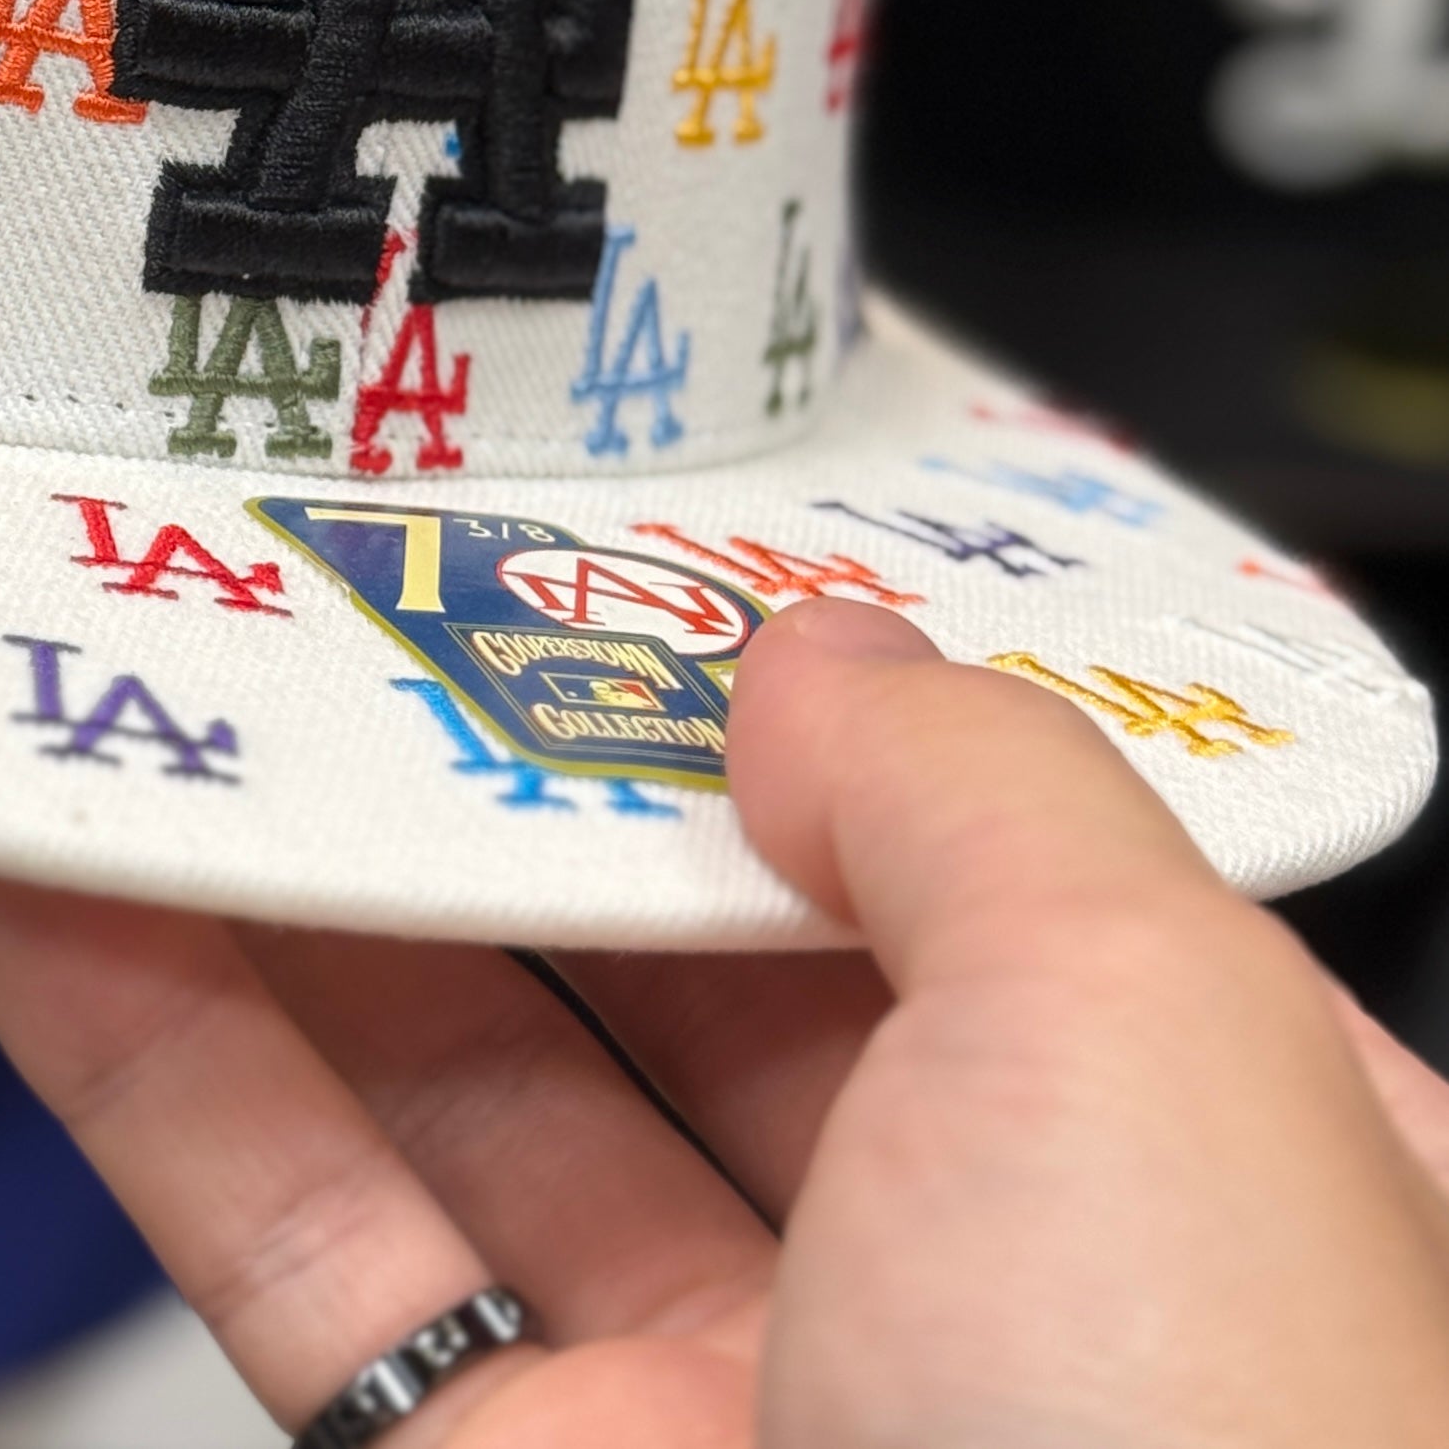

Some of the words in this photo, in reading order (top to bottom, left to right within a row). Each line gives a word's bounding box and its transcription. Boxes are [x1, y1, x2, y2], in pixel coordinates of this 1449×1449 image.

[570, 225, 691, 457] LA
[54, 496, 291, 617] LA
[304, 507, 446, 613] 7
[452, 518, 557, 543] 3/8
[628, 522, 926, 607] LA
[812, 500, 1085, 578] LA
[2, 634, 240, 782] LA
[471, 630, 684, 690] COOPERSTOWN
[987, 650, 1296, 760] LA
[531, 703, 727, 753] COLLECTION
